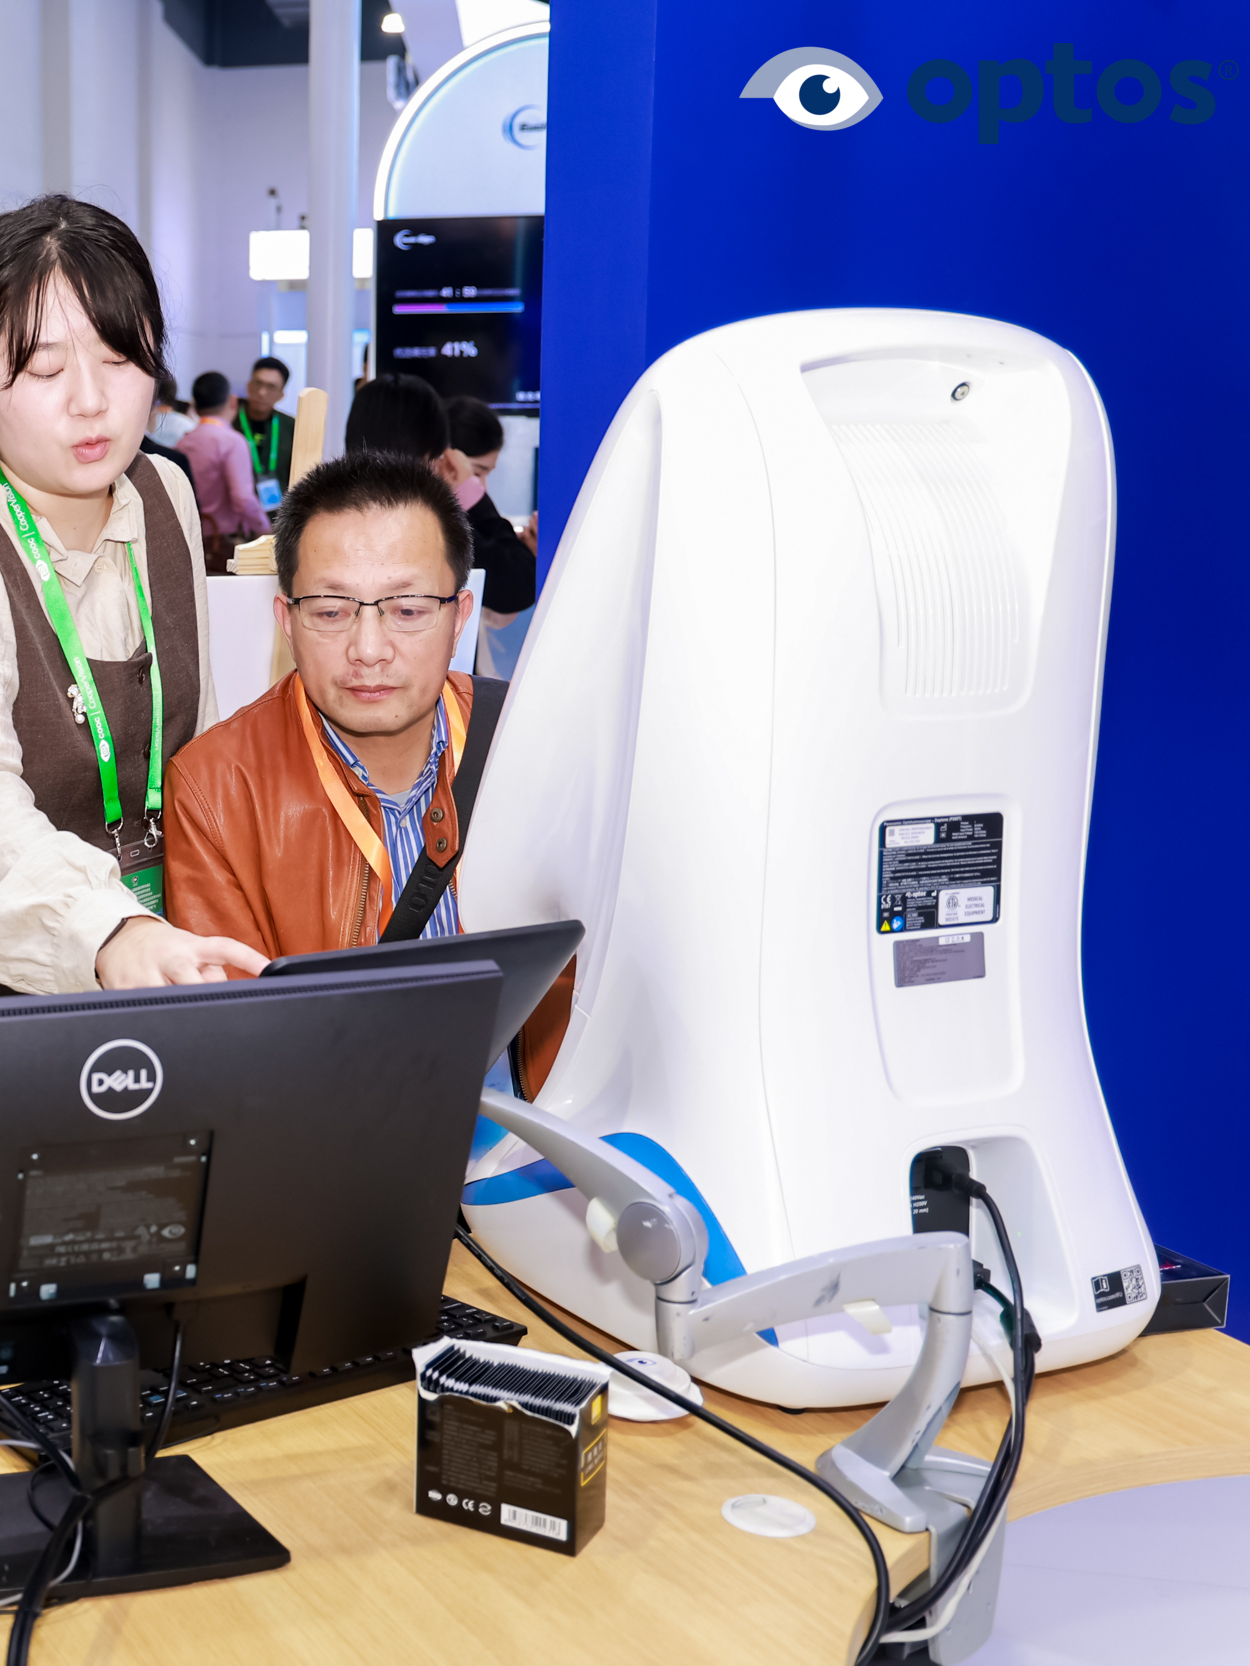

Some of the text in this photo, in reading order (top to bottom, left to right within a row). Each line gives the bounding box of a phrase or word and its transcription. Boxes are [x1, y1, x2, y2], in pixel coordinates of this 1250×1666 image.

[440, 341, 479, 358] 41%
[2, 481, 41, 560] cooc CooperVision
[73, 657, 105, 739] cooc CooperVision
[91, 1067, 154, 1094] DELL
